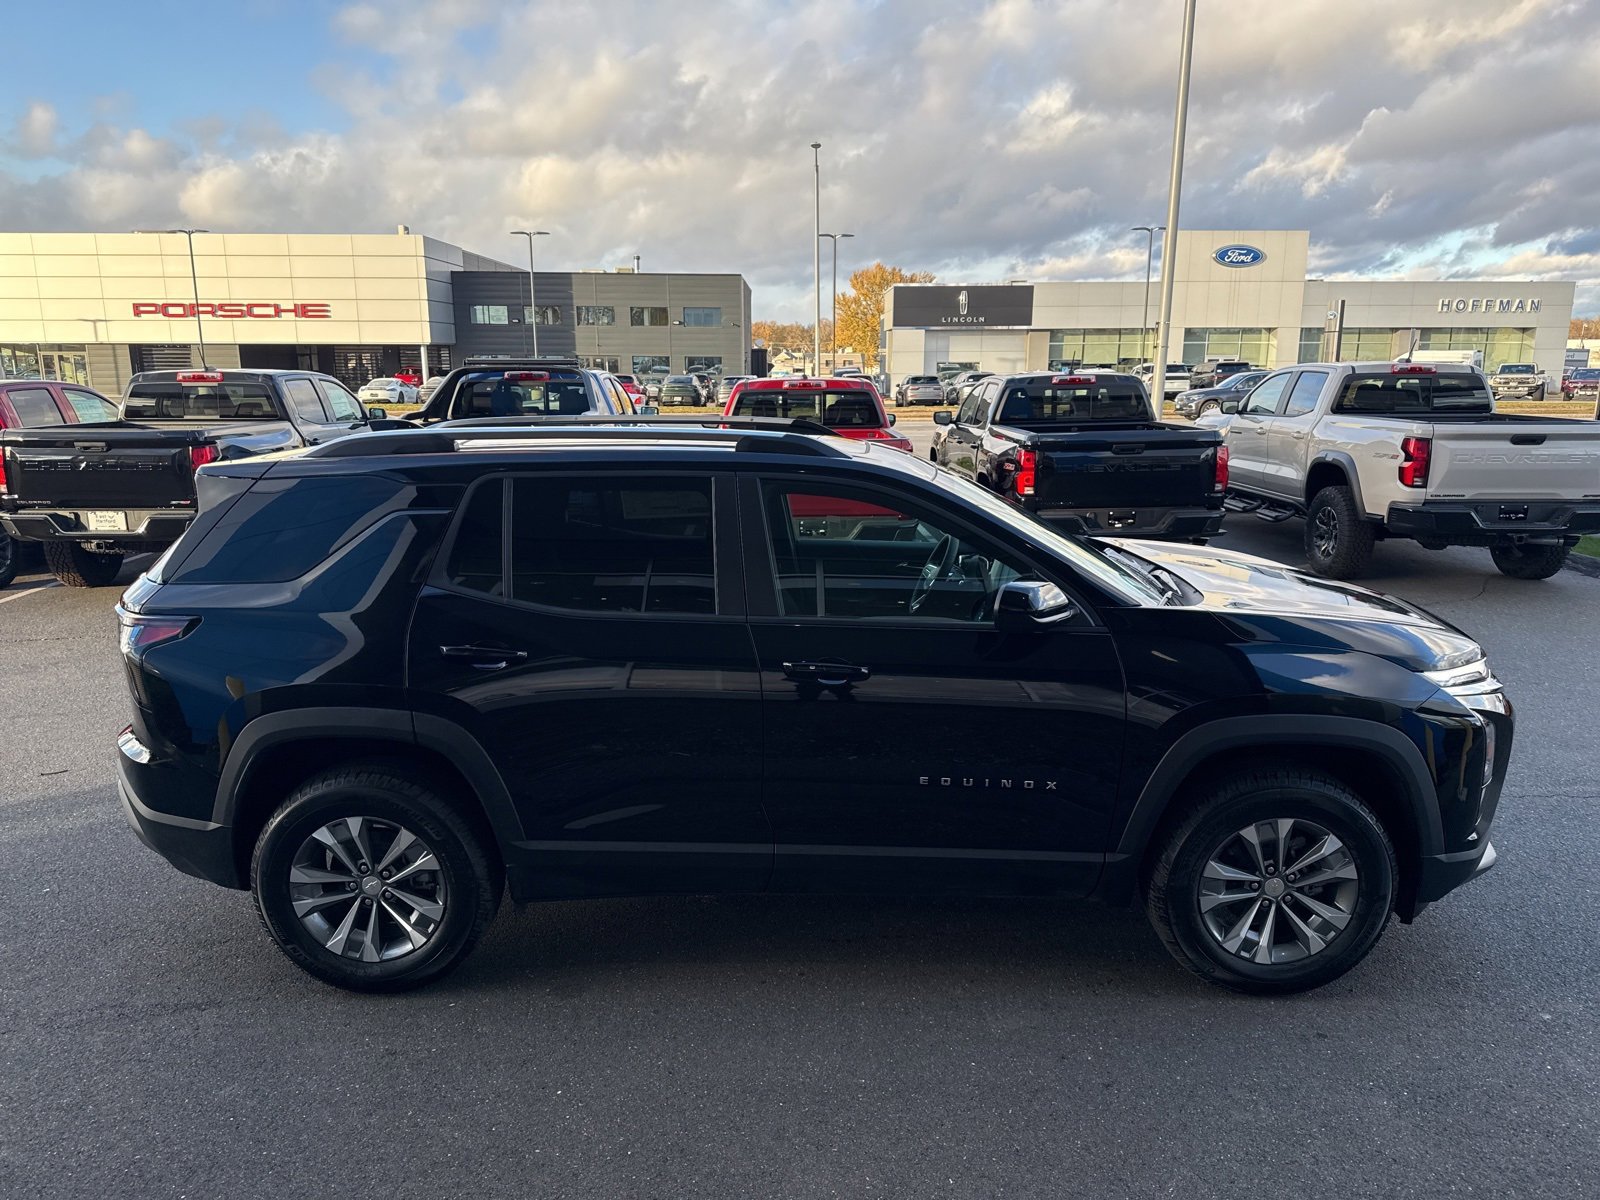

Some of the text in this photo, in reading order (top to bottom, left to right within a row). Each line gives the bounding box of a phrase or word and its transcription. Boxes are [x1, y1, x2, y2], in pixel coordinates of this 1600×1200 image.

[1224, 249, 1254, 262] Ford
[132, 303, 331, 318] PORSCHE
[1438, 299, 1542, 313] HOFFMAN
[1453, 452, 1599, 465] CHEVROLET
[919, 776, 1057, 790] EQUINOX
